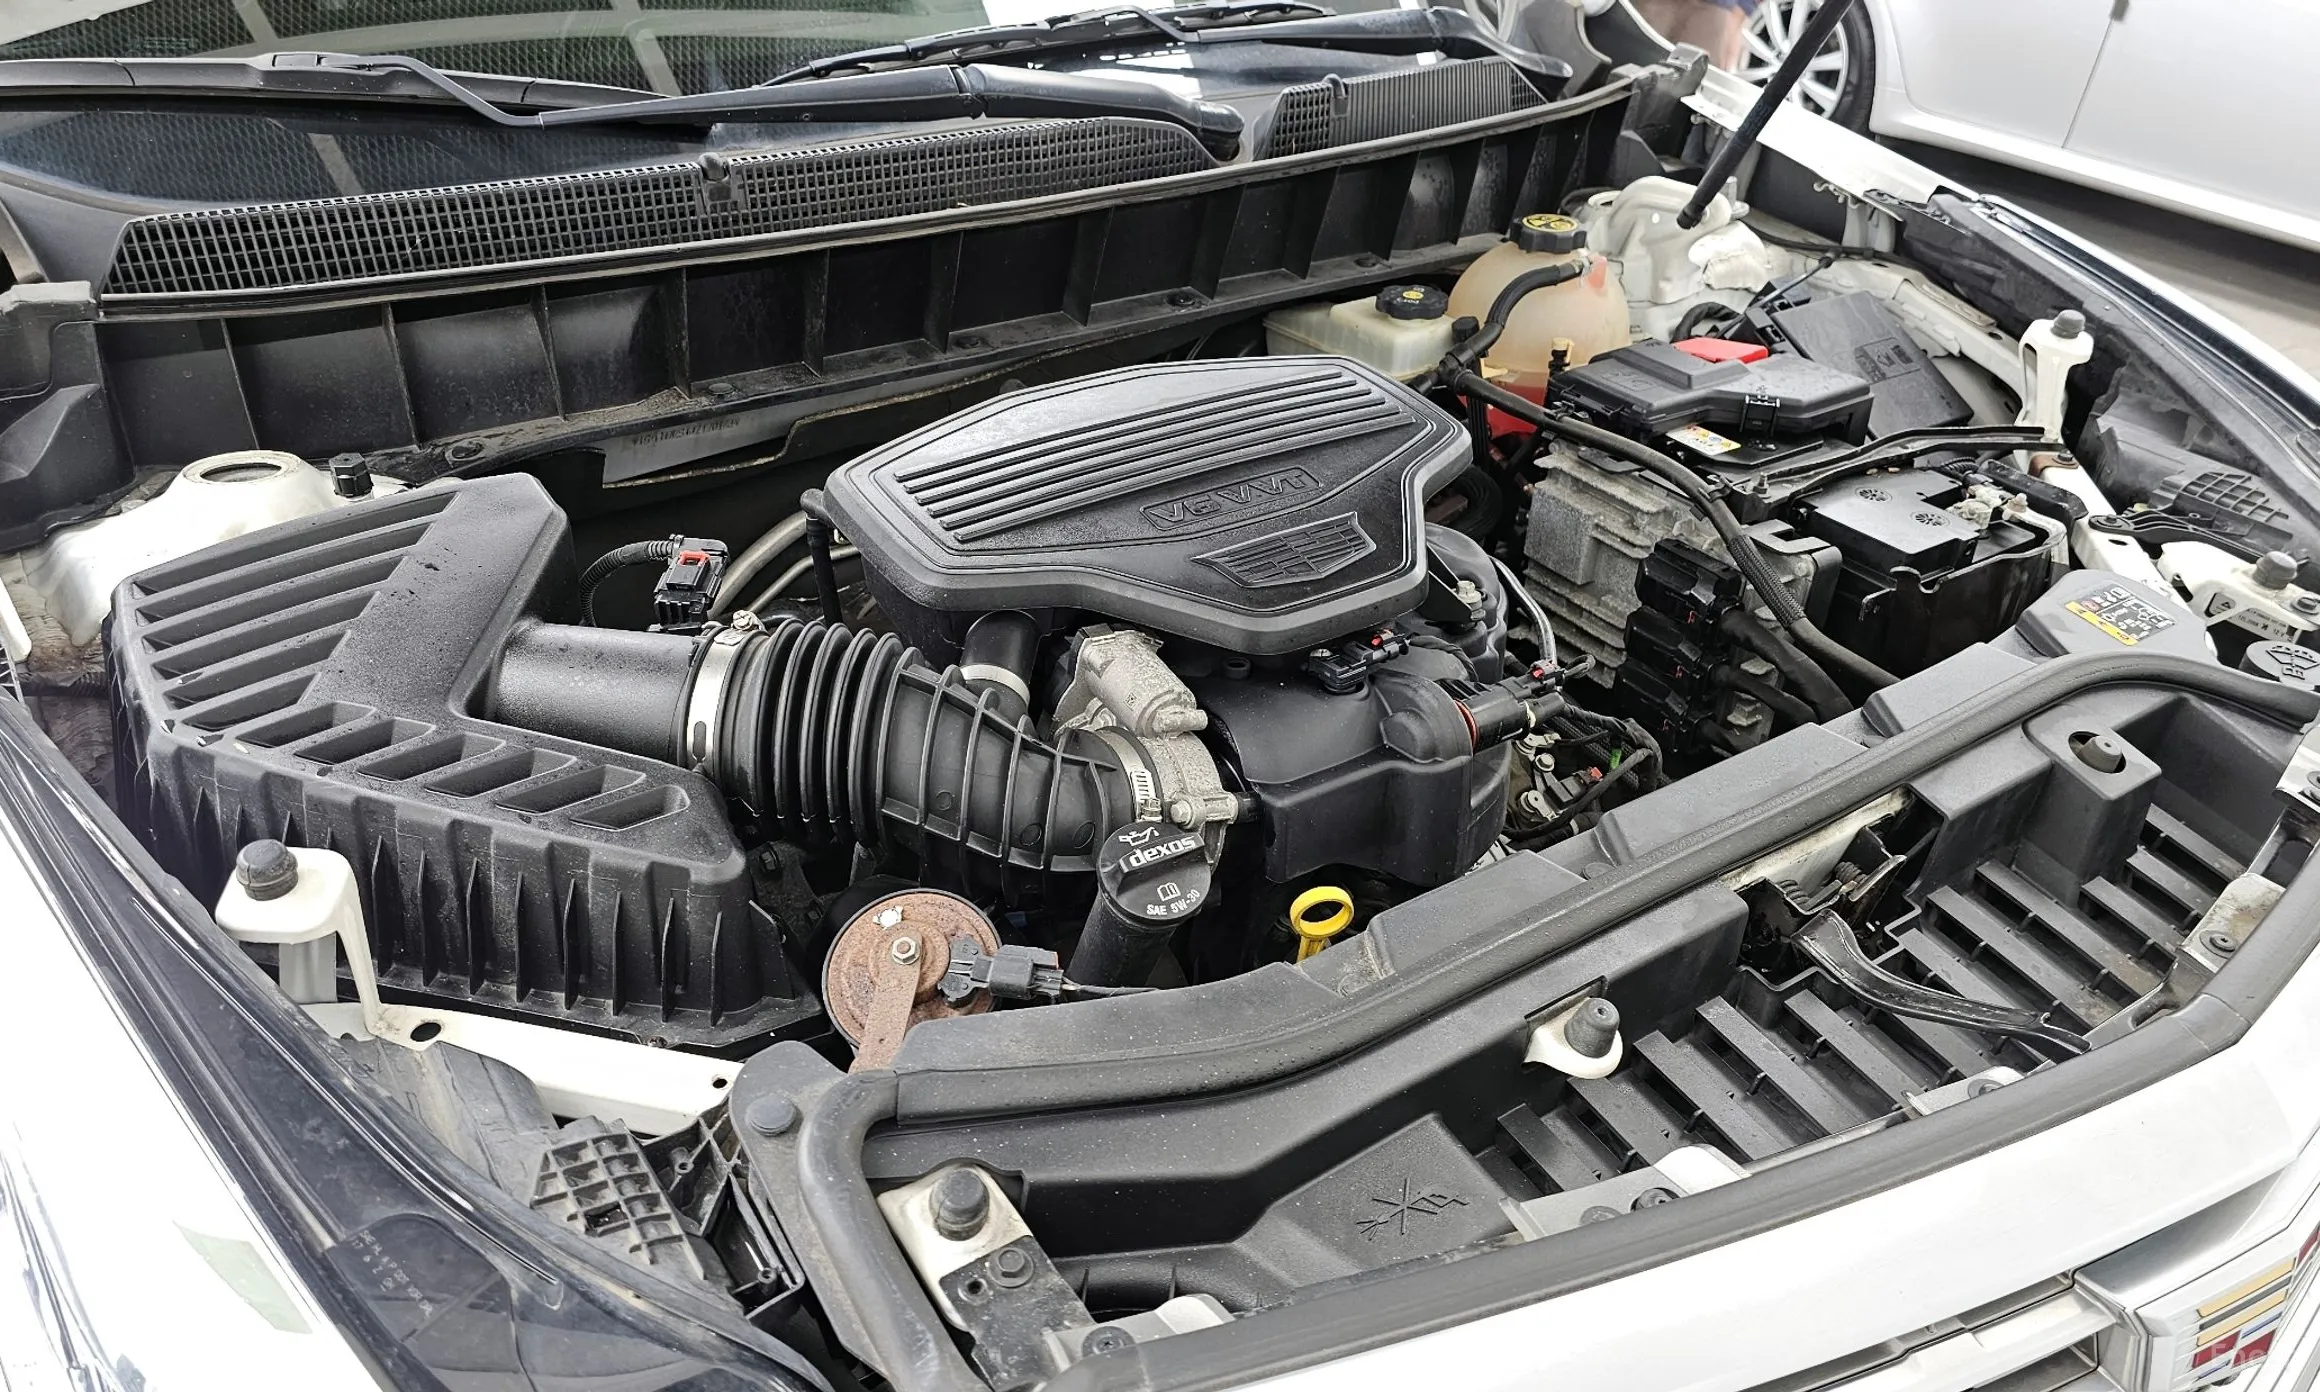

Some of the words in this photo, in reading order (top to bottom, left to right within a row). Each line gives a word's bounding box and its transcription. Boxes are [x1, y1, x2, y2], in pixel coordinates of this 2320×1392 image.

[1149, 495, 1222, 523] V6
[1128, 835, 1197, 867] dexos
[1146, 904, 1168, 916] SAE
[1169, 888, 1201, 914] 5W-30
